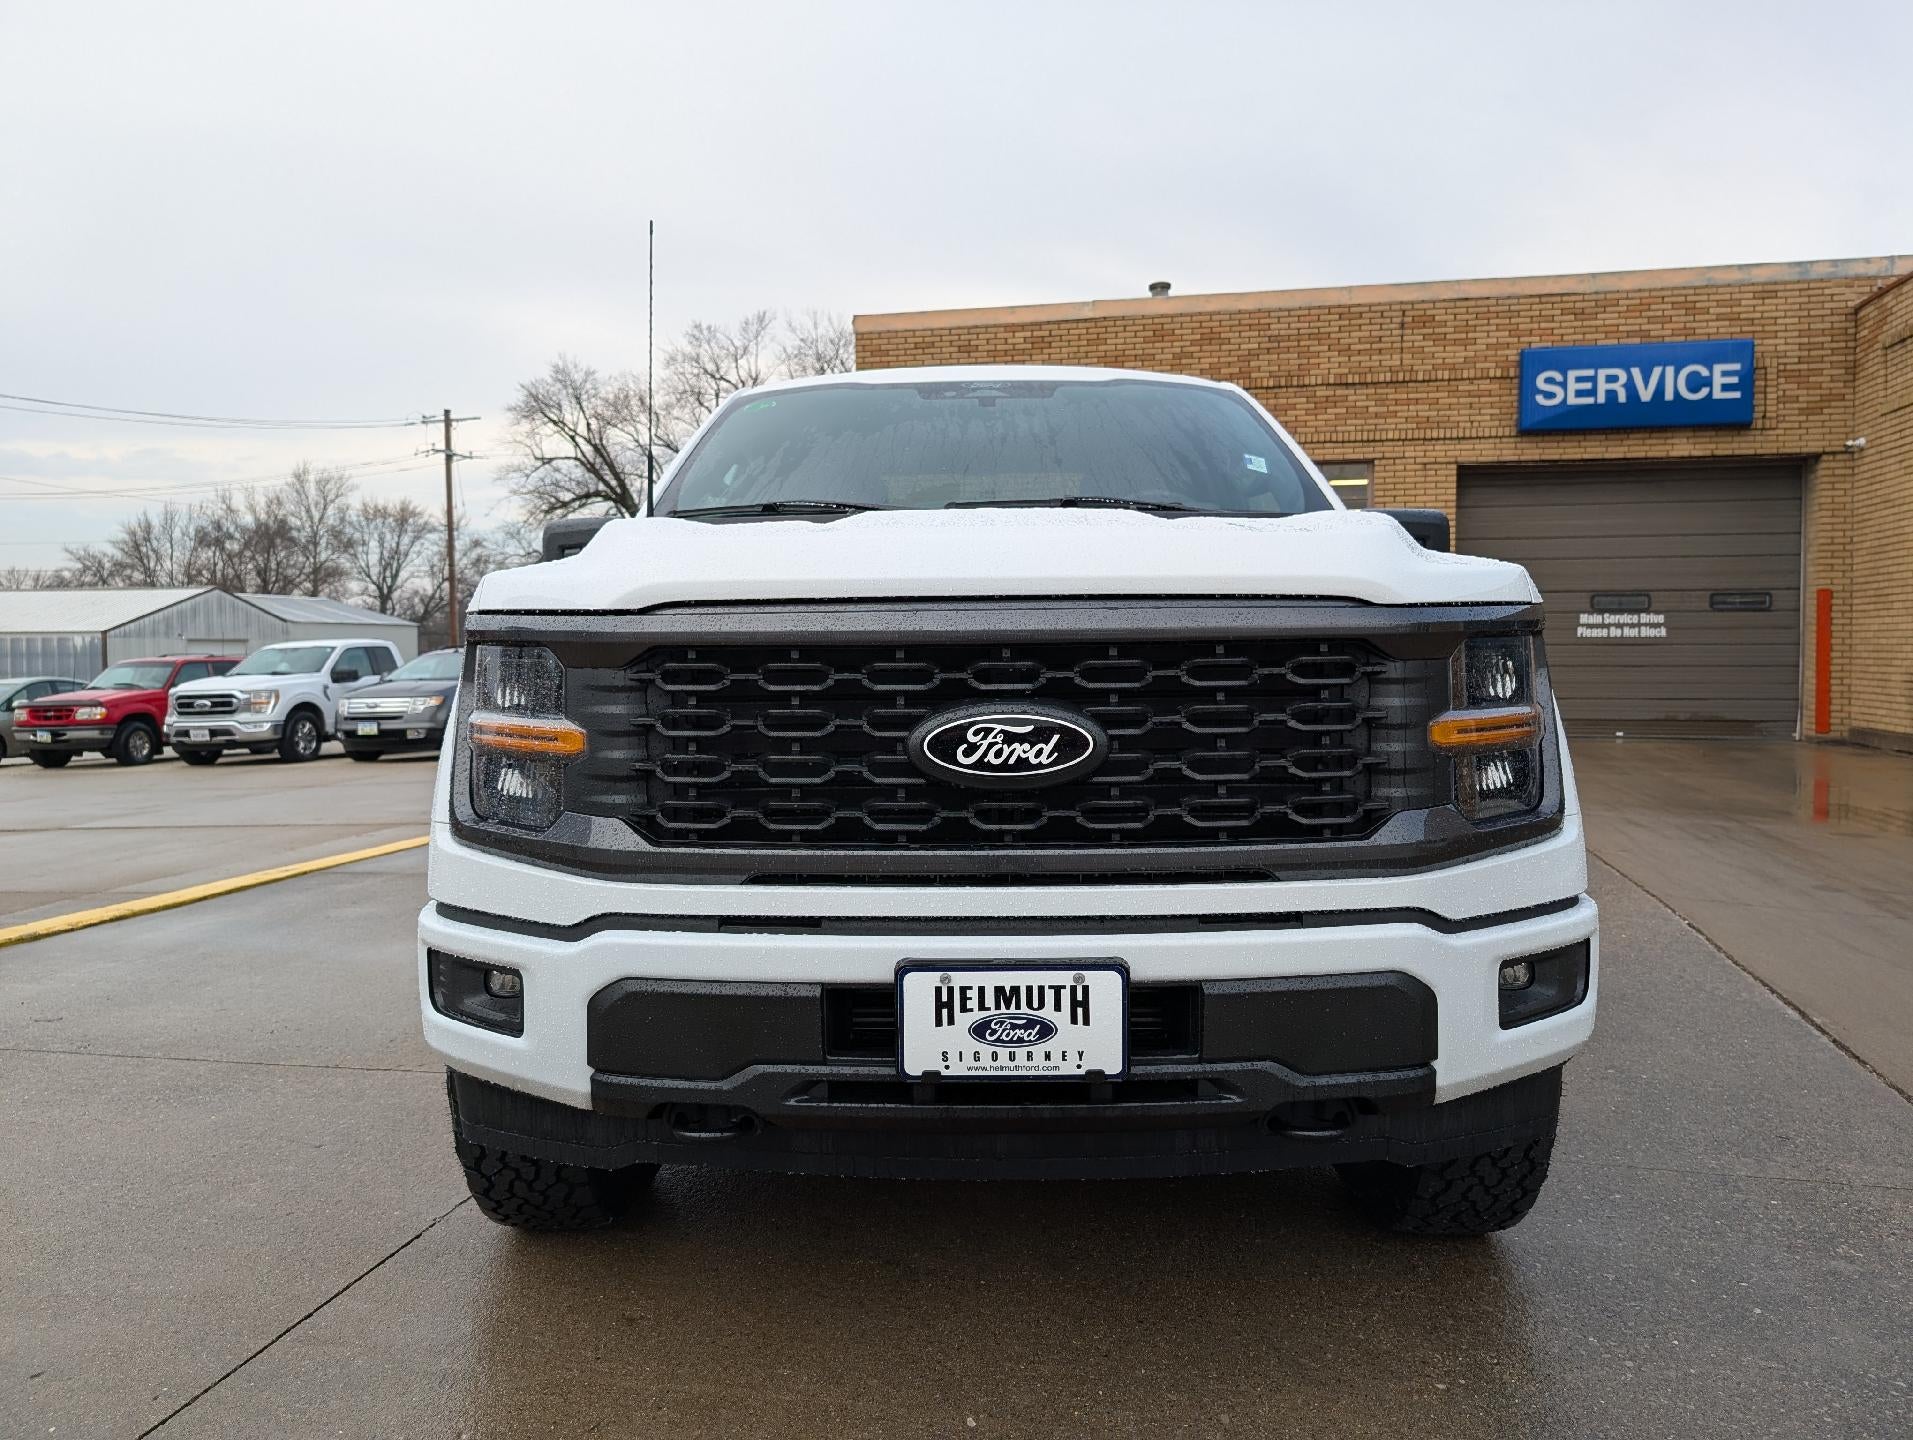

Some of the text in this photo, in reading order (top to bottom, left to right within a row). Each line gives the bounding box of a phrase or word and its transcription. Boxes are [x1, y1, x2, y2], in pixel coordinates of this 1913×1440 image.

[1535, 363, 1741, 407] SERVICE
[1580, 613, 1664, 624] Main Service Drive
[1577, 626, 1667, 637] Please Do Not Block
[956, 723, 1060, 765] Ford
[934, 985, 1090, 1027] HELMUTH
[985, 1018, 1040, 1041] Ford
[941, 1051, 1085, 1062] SIGOURNEY
